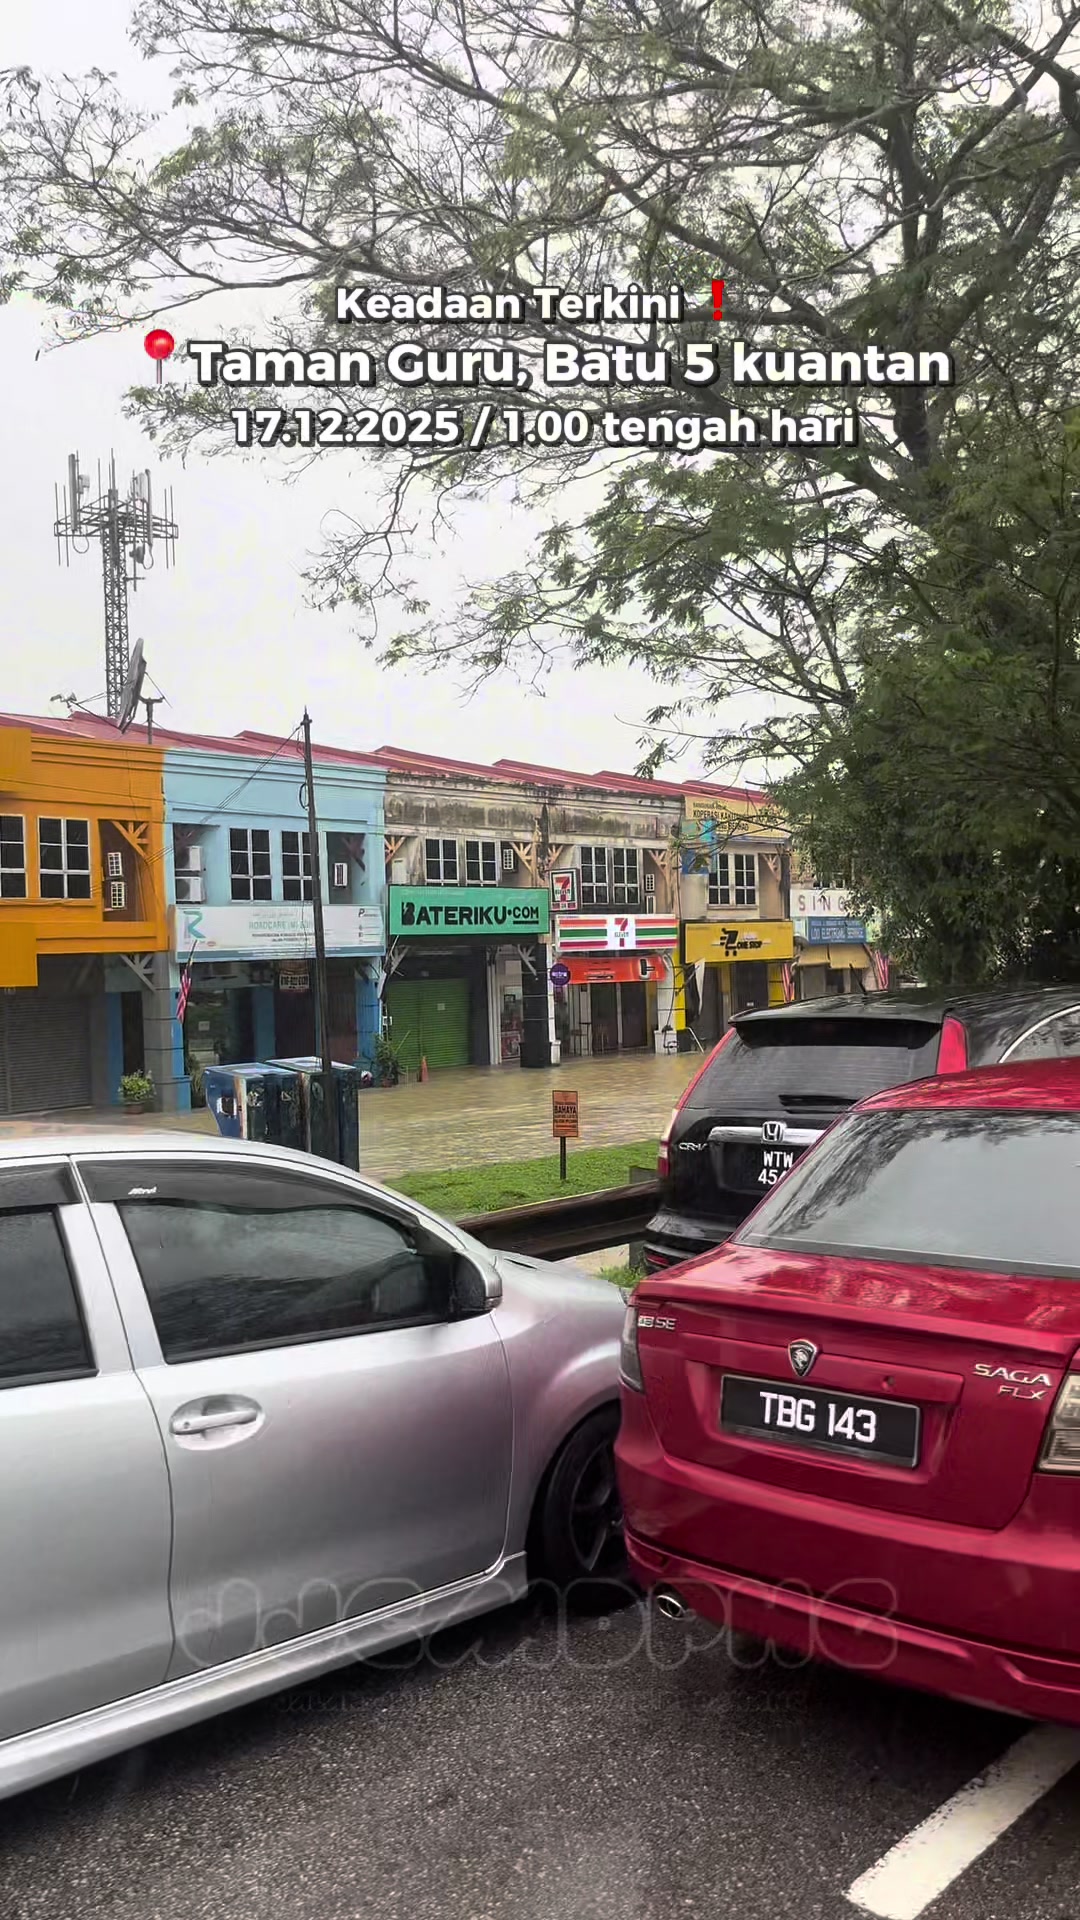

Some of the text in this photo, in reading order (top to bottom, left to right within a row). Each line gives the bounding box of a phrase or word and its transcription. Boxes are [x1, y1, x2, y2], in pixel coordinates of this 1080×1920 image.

[763, 1151, 793, 1168] WTW
[973, 1363, 1052, 1387] SAGA
[997, 1385, 1048, 1401] FLX
[759, 1391, 877, 1444] TBG 143
